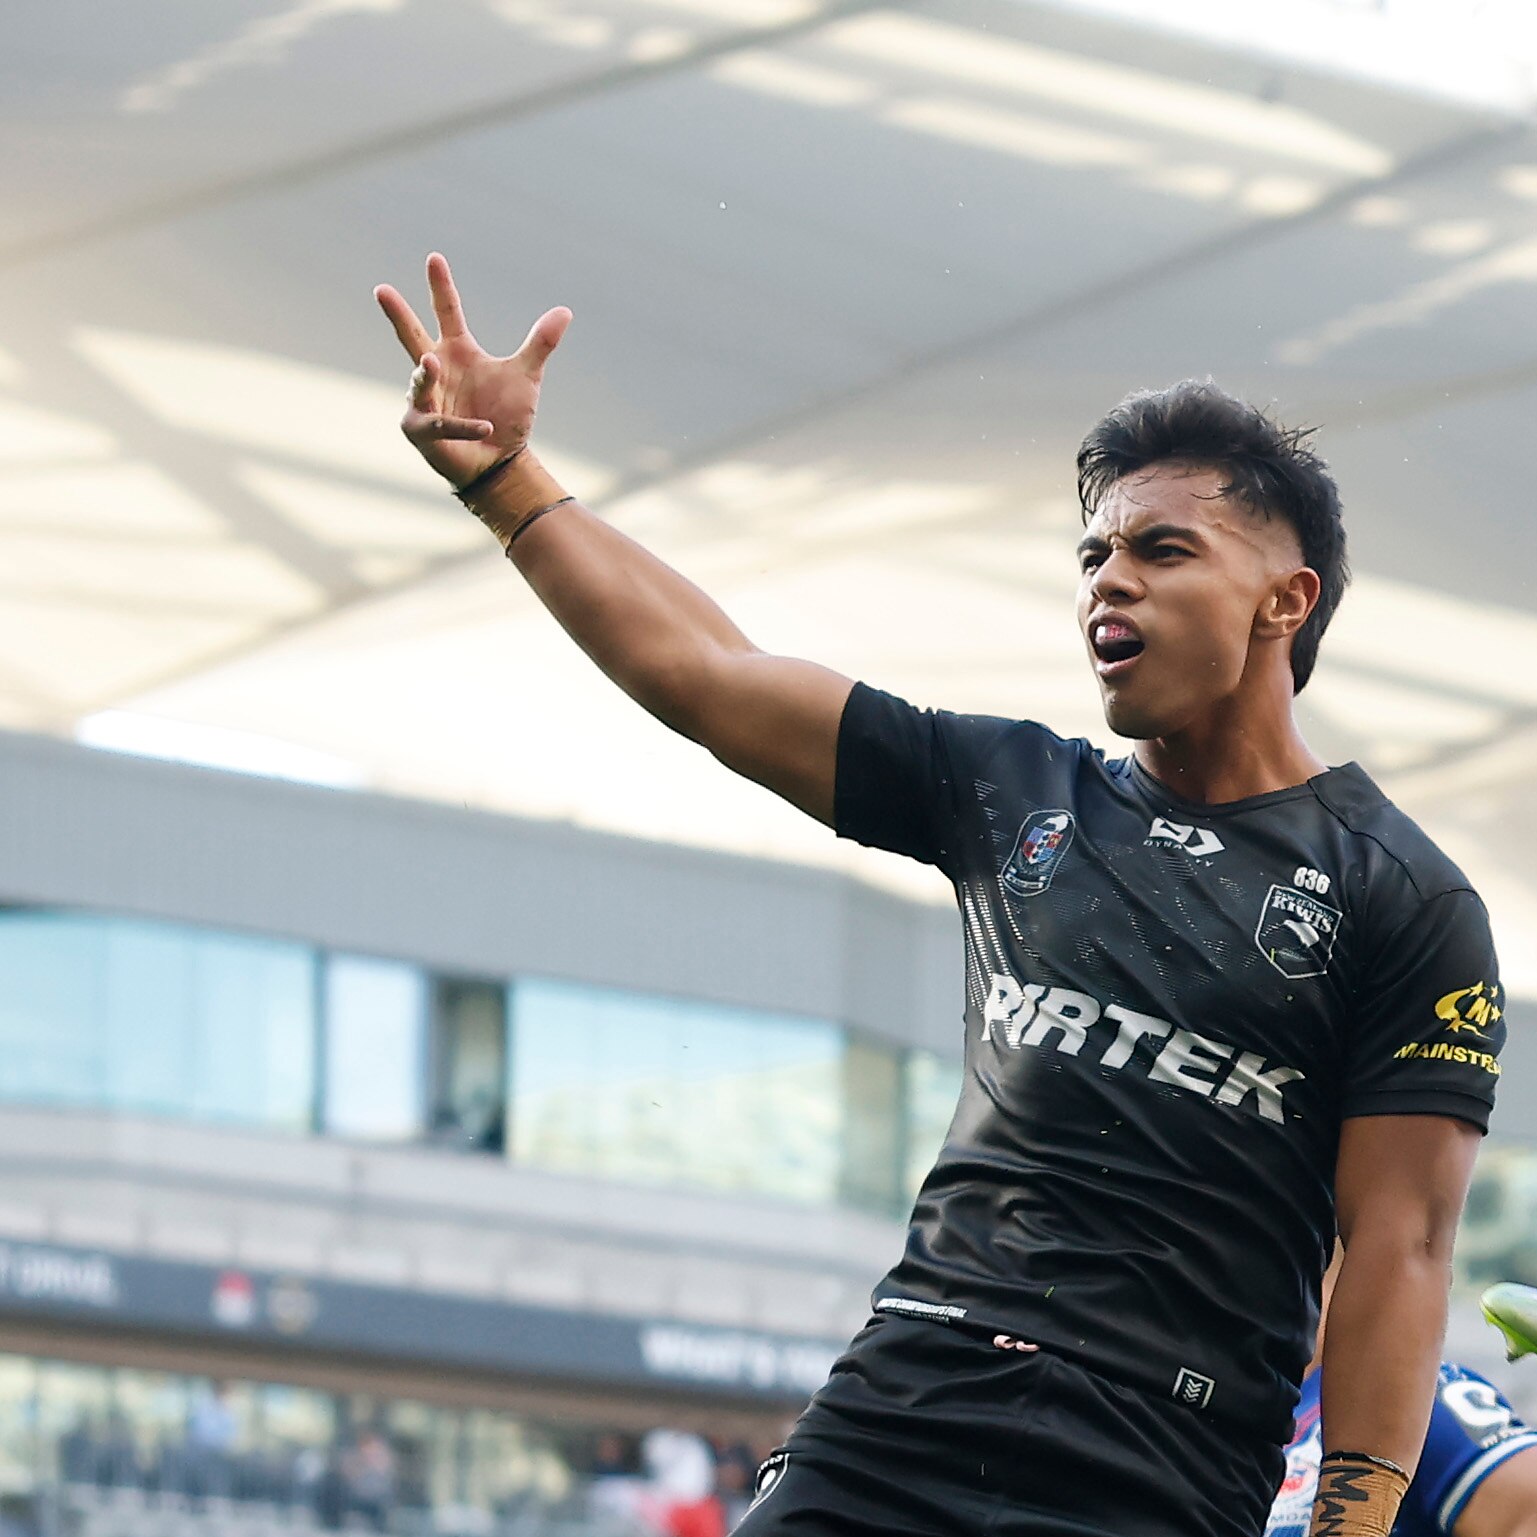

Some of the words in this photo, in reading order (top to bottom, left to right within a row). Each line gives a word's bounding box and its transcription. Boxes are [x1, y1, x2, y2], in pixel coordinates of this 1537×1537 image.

[1293, 866, 1331, 895] 836
[1271, 894, 1333, 934] KIWIS
[981, 972, 1306, 1125] PIRTEK
